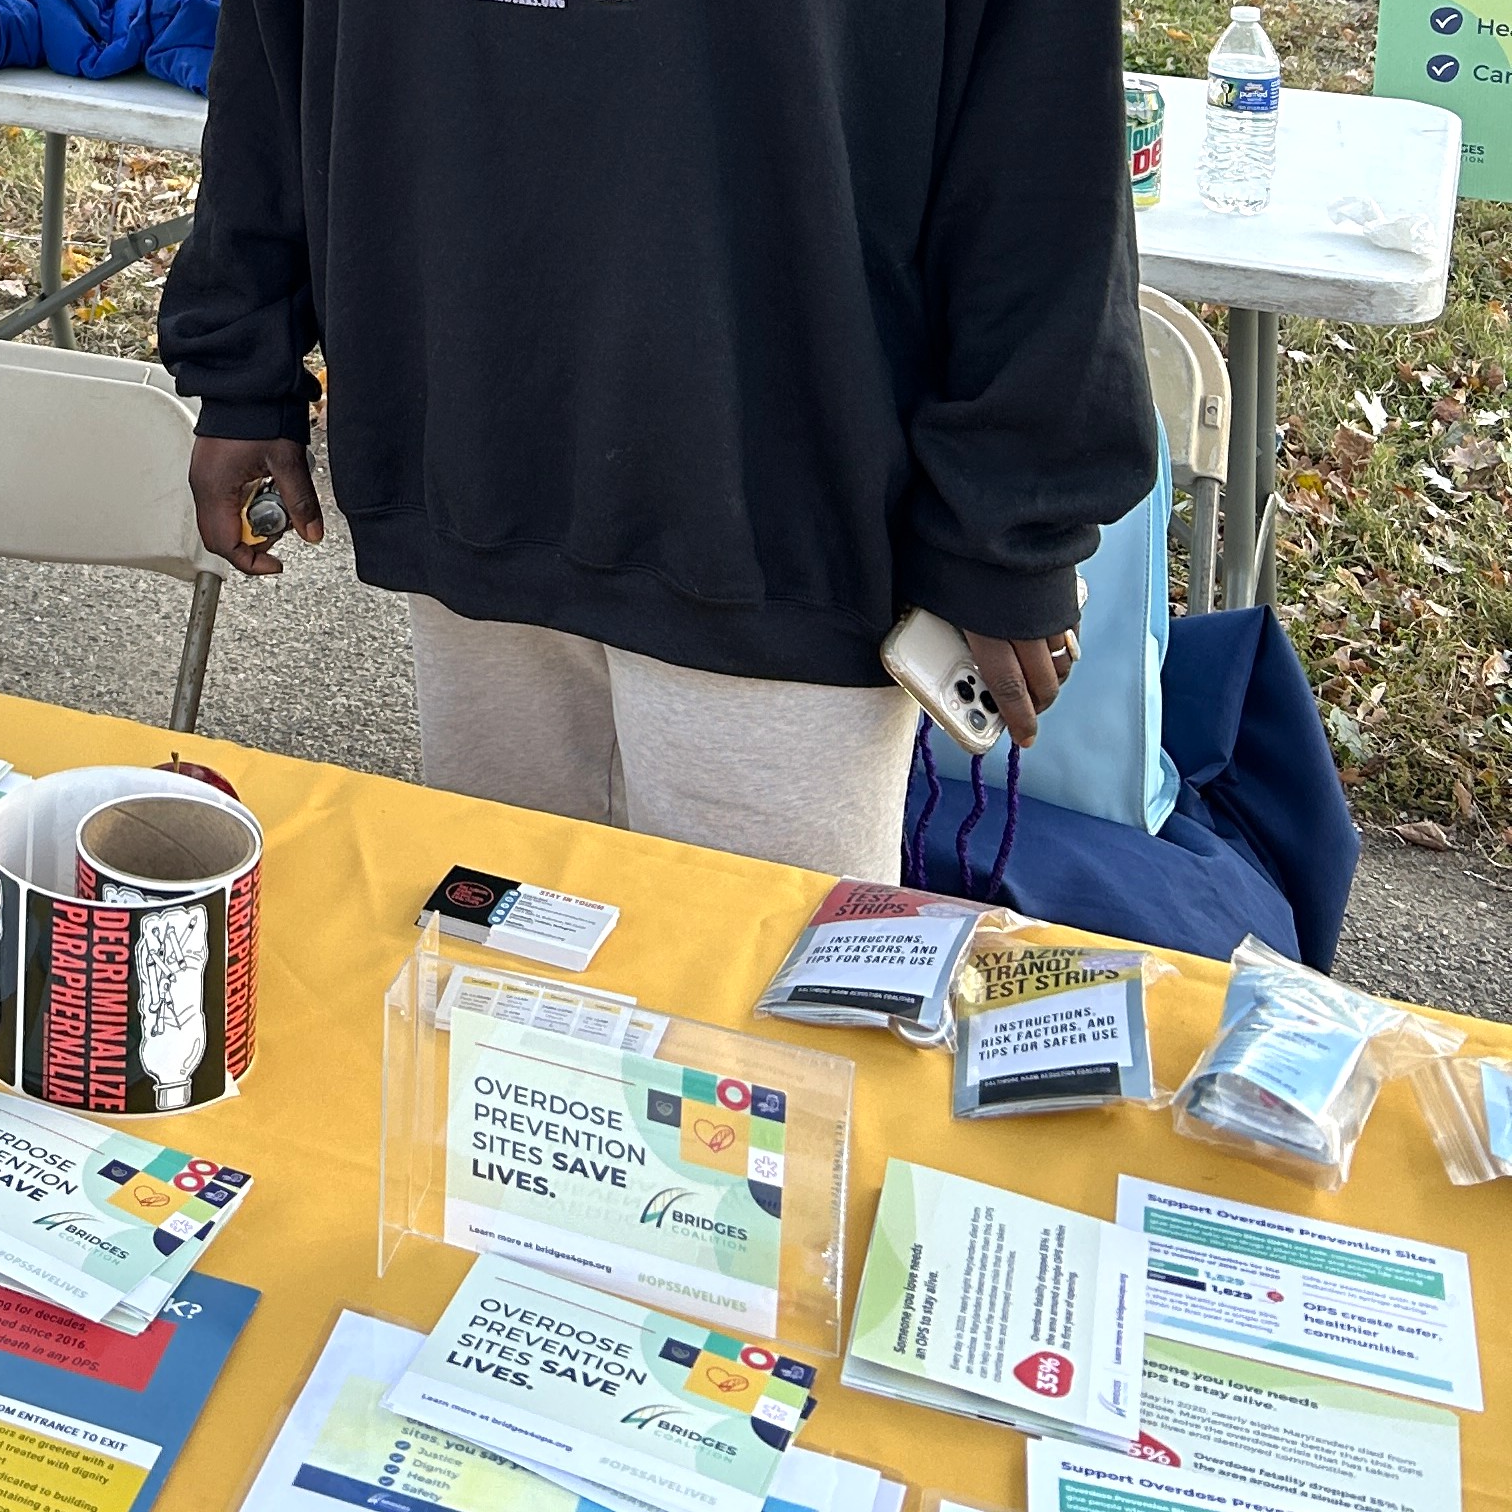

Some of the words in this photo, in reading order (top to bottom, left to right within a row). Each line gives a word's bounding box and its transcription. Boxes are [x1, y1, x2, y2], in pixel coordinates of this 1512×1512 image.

[539, 890, 561, 900] STAY
[574, 899, 605, 911] TOUCH
[835, 903, 908, 916] STRIPS
[846, 892, 894, 904] TEST
[812, 945, 840, 955] RISK
[910, 946, 938, 955] AND
[830, 935, 924, 945] INSTRUCTIONS,
[226, 878, 253, 1079] PARAPHERNALIA
[806, 955, 832, 965] TIPS
[836, 955, 861, 963] FOR
[864, 955, 906, 965] SAFER
[909, 957, 935, 966] USE
[1035, 968, 1119, 990] STRIPS
[49, 901, 88, 1105] PARAPHERNALIA
[89, 909, 131, 1112] DECRIMINALIZE
[994, 1007, 1097, 1034] INSTRUCTIONS,
[979, 1047, 1008, 1061] TIPS
[1013, 1040, 1038, 1054] FOR
[1043, 1033, 1087, 1049] SAFER
[1092, 1028, 1119, 1041] USE
[981, 1034, 1011, 1048] RISK
[1087, 1015, 1115, 1029] AND
[474, 1076, 624, 1131] OVERDOSE
[473, 1104, 646, 1166] PREVENTION
[472, 1132, 544, 1166] SITES
[552, 1151, 628, 1189] SAVE
[472, 1158, 557, 1198] LIVES.
[67, 1223, 129, 1260] BRIDGES
[671, 1224, 747, 1254] COALITION
[672, 1210, 748, 1241] BRIDGES
[1147, 1194, 1212, 1215] Support
[1216, 1210, 1295, 1234] Overdose
[1299, 1228, 1391, 1256] Prevention
[1395, 1249, 1437, 1265] Sites
[468, 1224, 496, 1240] Learn
[497, 1233, 521, 1246] more
[523, 1239, 534, 1249] at
[535, 1242, 612, 1274] bridges4ops.org
[637, 1272, 748, 1313] #OPSSAVELIVES
[13, 1298, 33, 1314] for
[37, 1308, 89, 1334] decades,
[480, 1298, 632, 1360] OVERDOSE
[445, 1350, 534, 1390] LIVES.
[456, 1333, 533, 1369] SITES
[538, 1359, 621, 1399] SAVE
[468, 1315, 647, 1387] PREVENTION
[1036, 1356, 1062, 1395] 35%
[17, 1411, 79, 1437] ENTRANCE
[83, 1431, 98, 1443] TO
[99, 1436, 128, 1452] EXIT
[658, 1418, 737, 1458] BRIDGES
